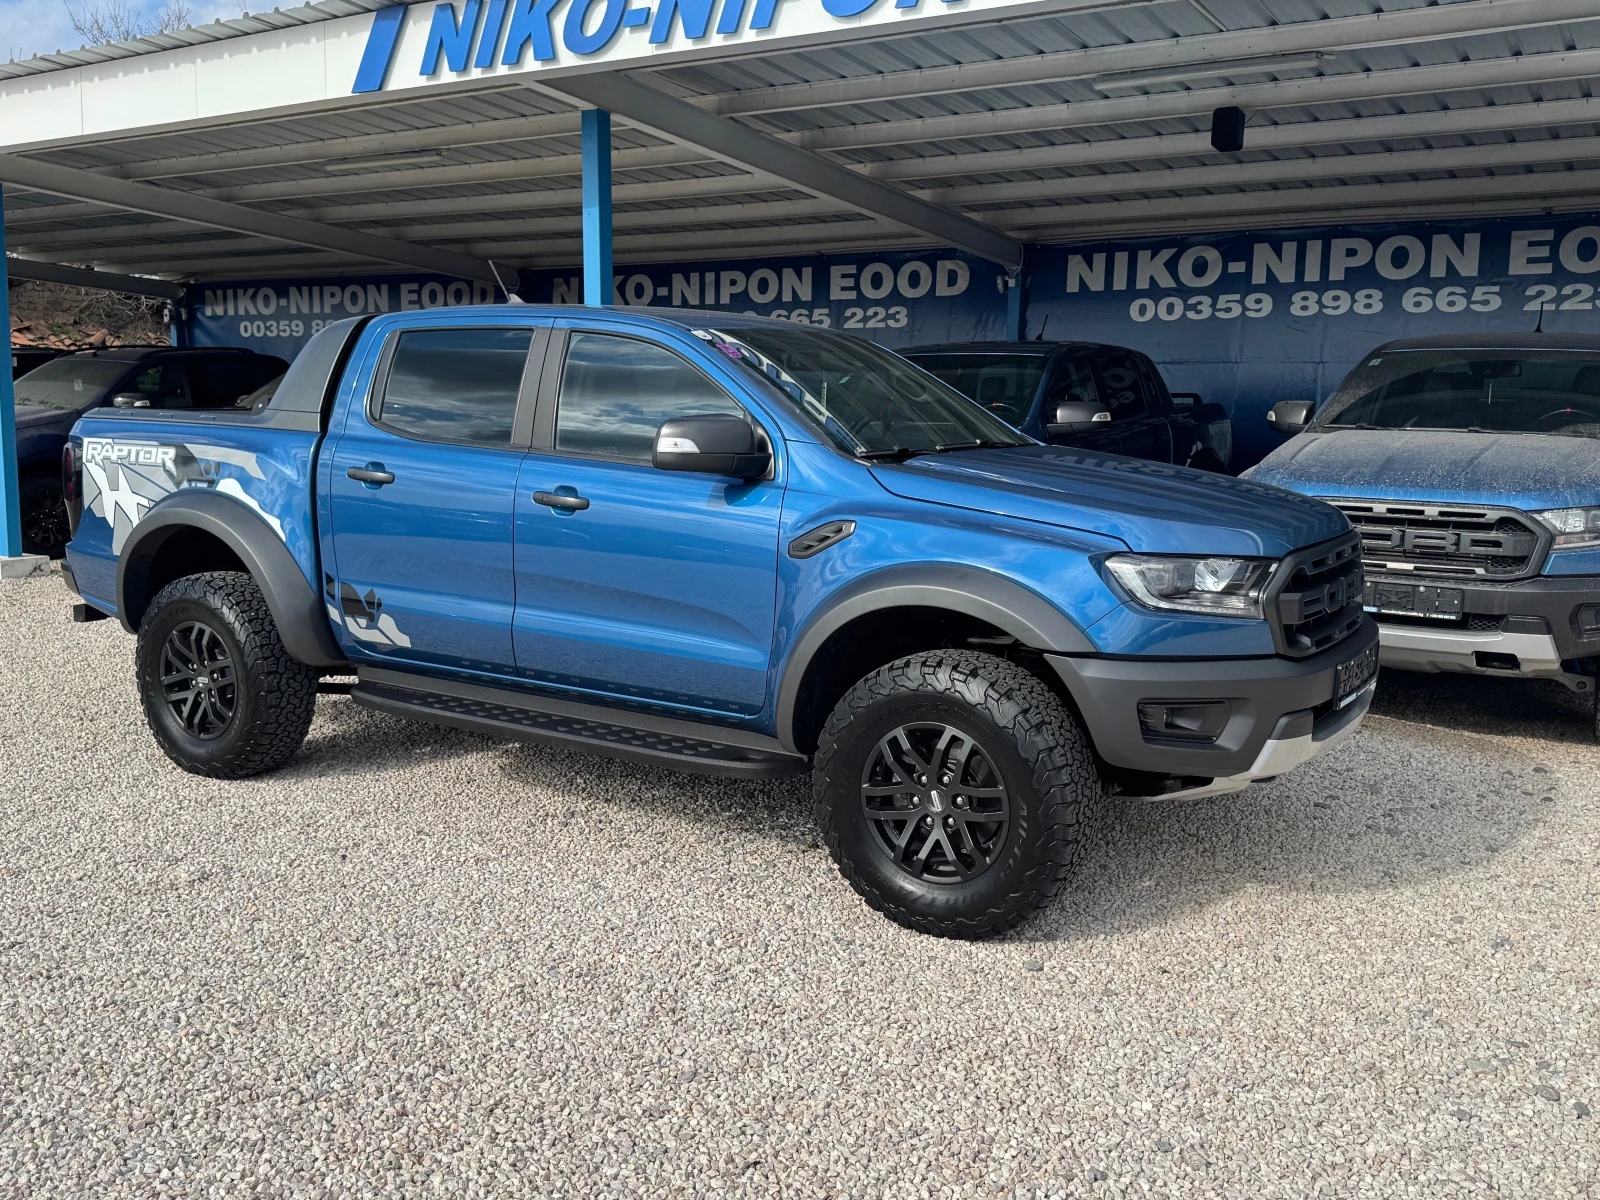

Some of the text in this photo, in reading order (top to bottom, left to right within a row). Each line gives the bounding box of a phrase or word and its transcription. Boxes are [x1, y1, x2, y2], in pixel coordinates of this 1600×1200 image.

[1065, 232, 1481, 293] NIKO-NIPON
[204, 281, 495, 317] NIKO-NIPON EOOD
[552, 259, 971, 306] NO-NIPON EOOD
[843, 305, 909, 329] 223
[1129, 283, 1600, 323] 00359 898 665 22
[239, 320, 305, 338] 00359
[86, 441, 177, 478] RAPTOR
[1361, 526, 1506, 557] ORD
[1298, 566, 1364, 623] FOR
